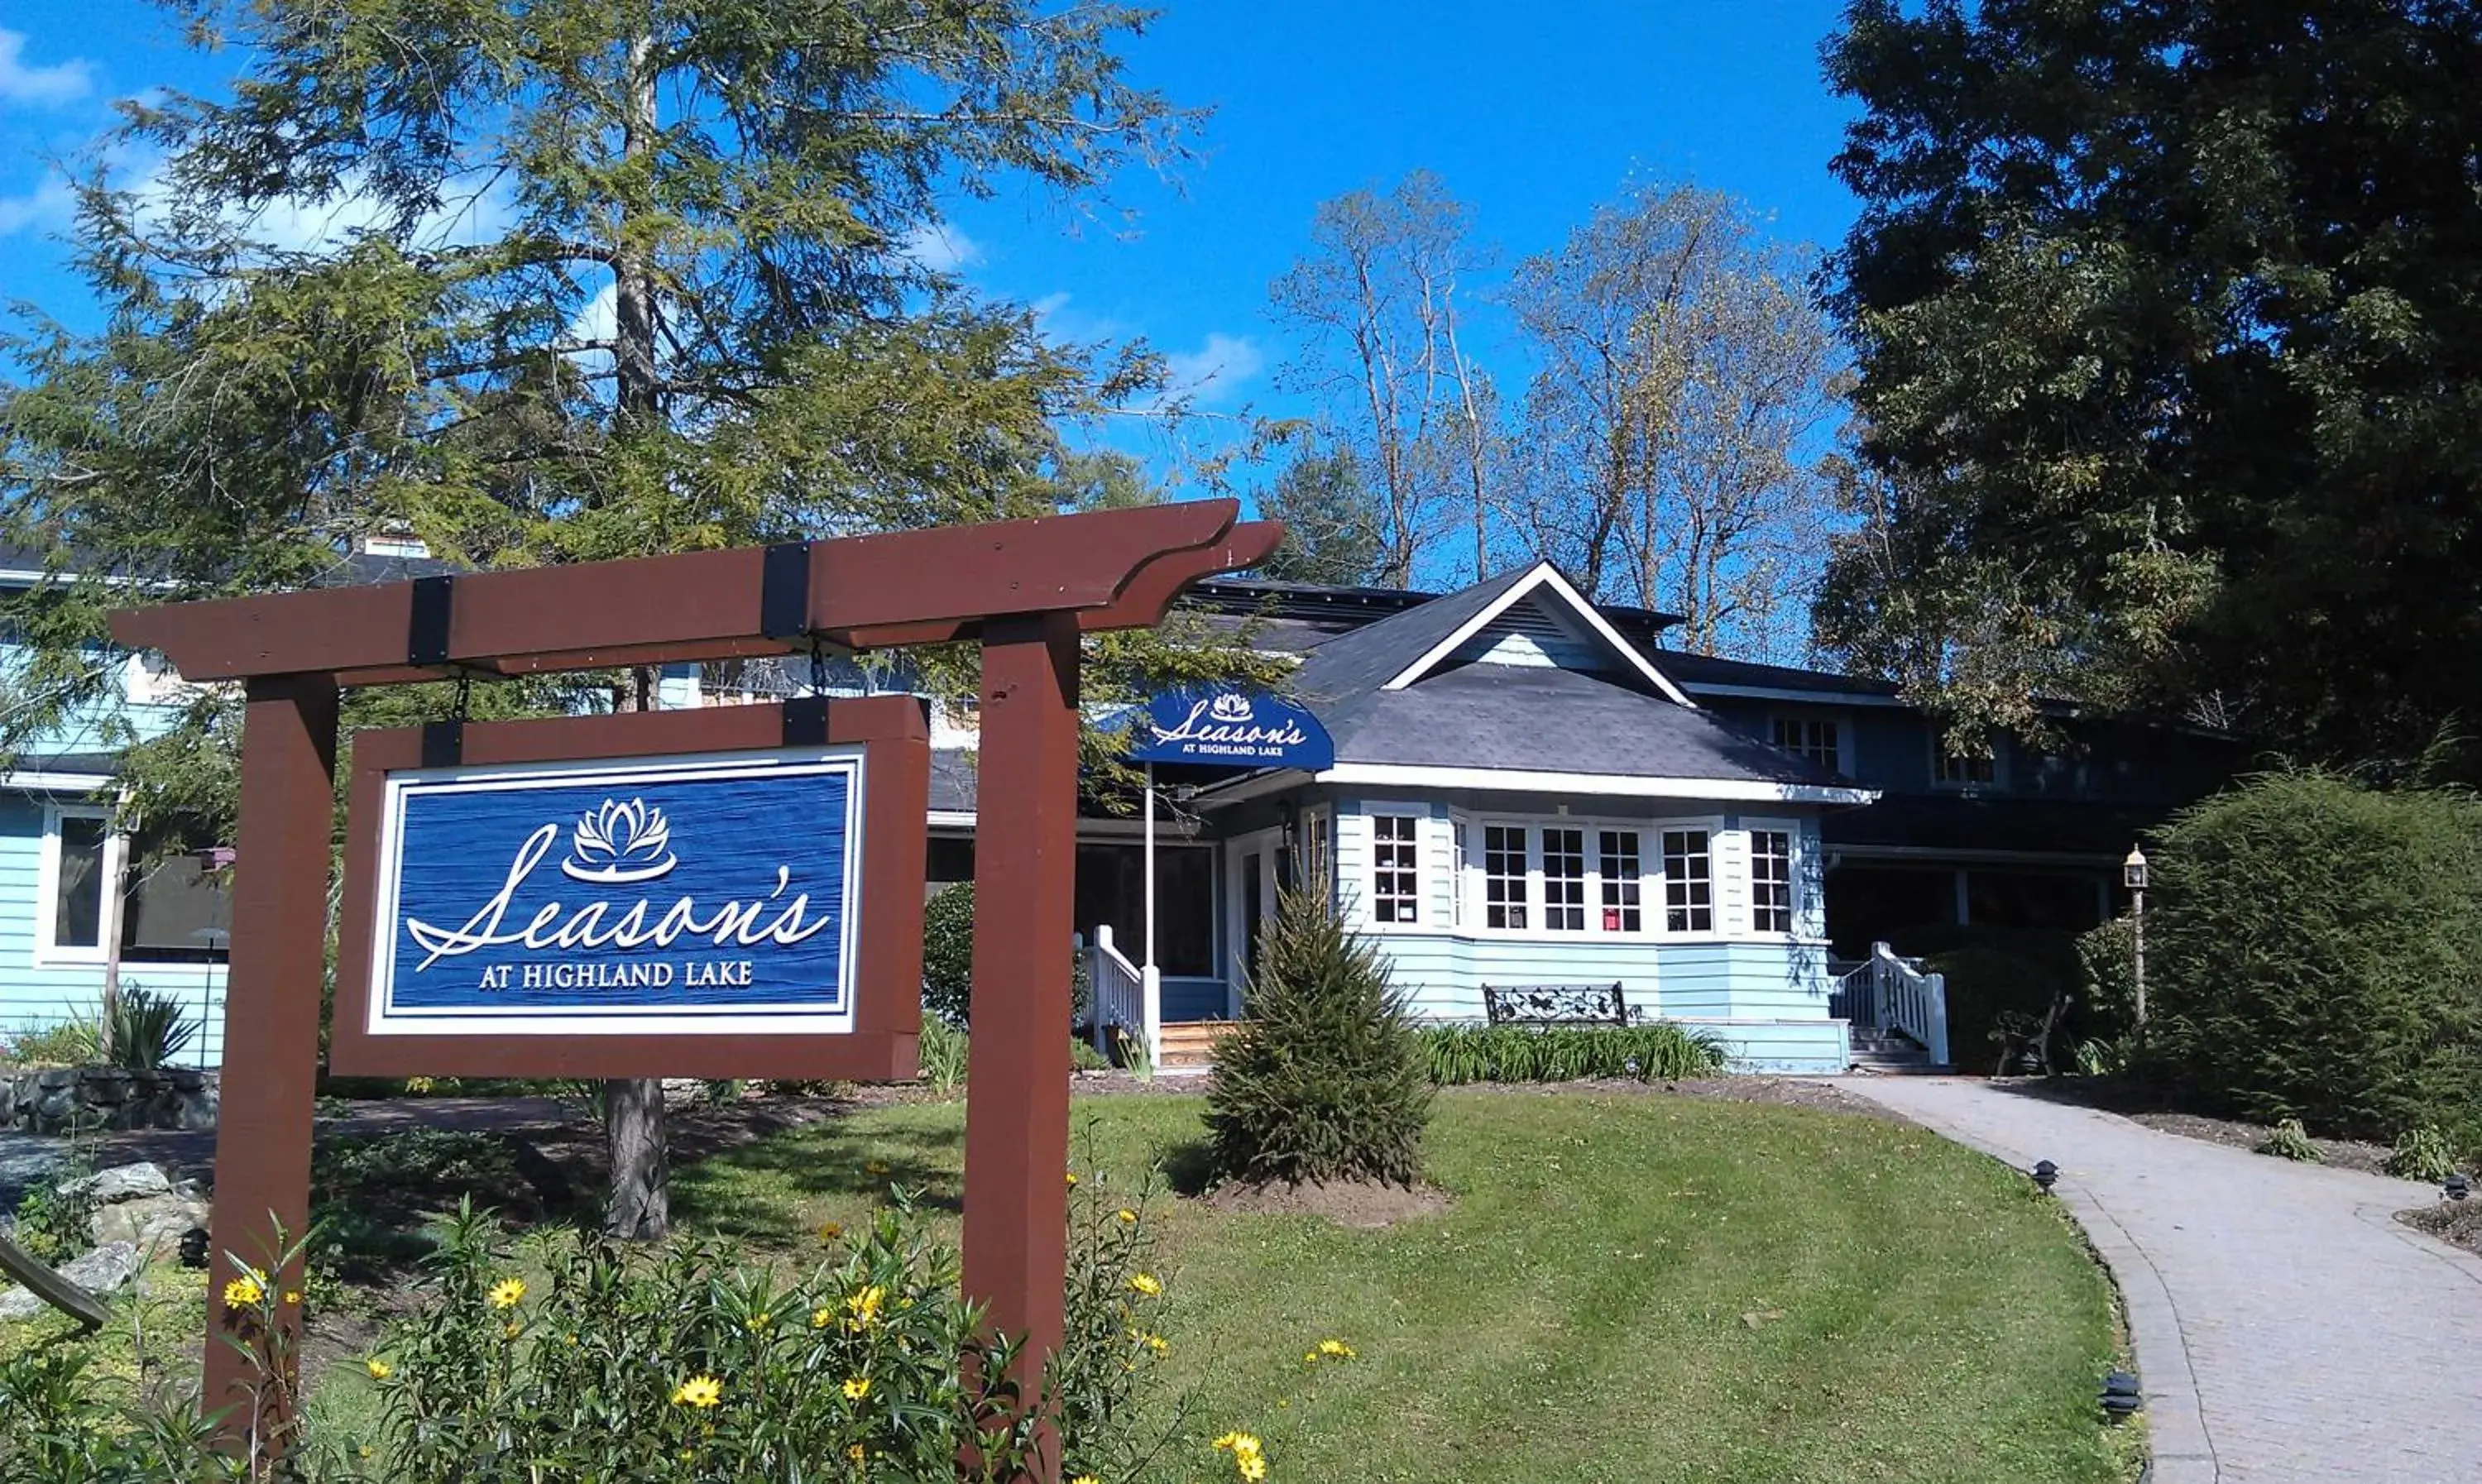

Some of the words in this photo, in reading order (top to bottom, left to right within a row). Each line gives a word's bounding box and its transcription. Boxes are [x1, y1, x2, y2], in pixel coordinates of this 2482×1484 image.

[1151, 699, 1306, 745] Season's
[1183, 744, 1195, 754] AT
[1200, 745, 1255, 755] HIGHLAND
[1259, 747, 1283, 757] LAKE
[406, 823, 830, 973] Season's
[478, 965, 510, 989] AT
[522, 962, 673, 989] HIGHLAND
[685, 960, 753, 986] LAKE
